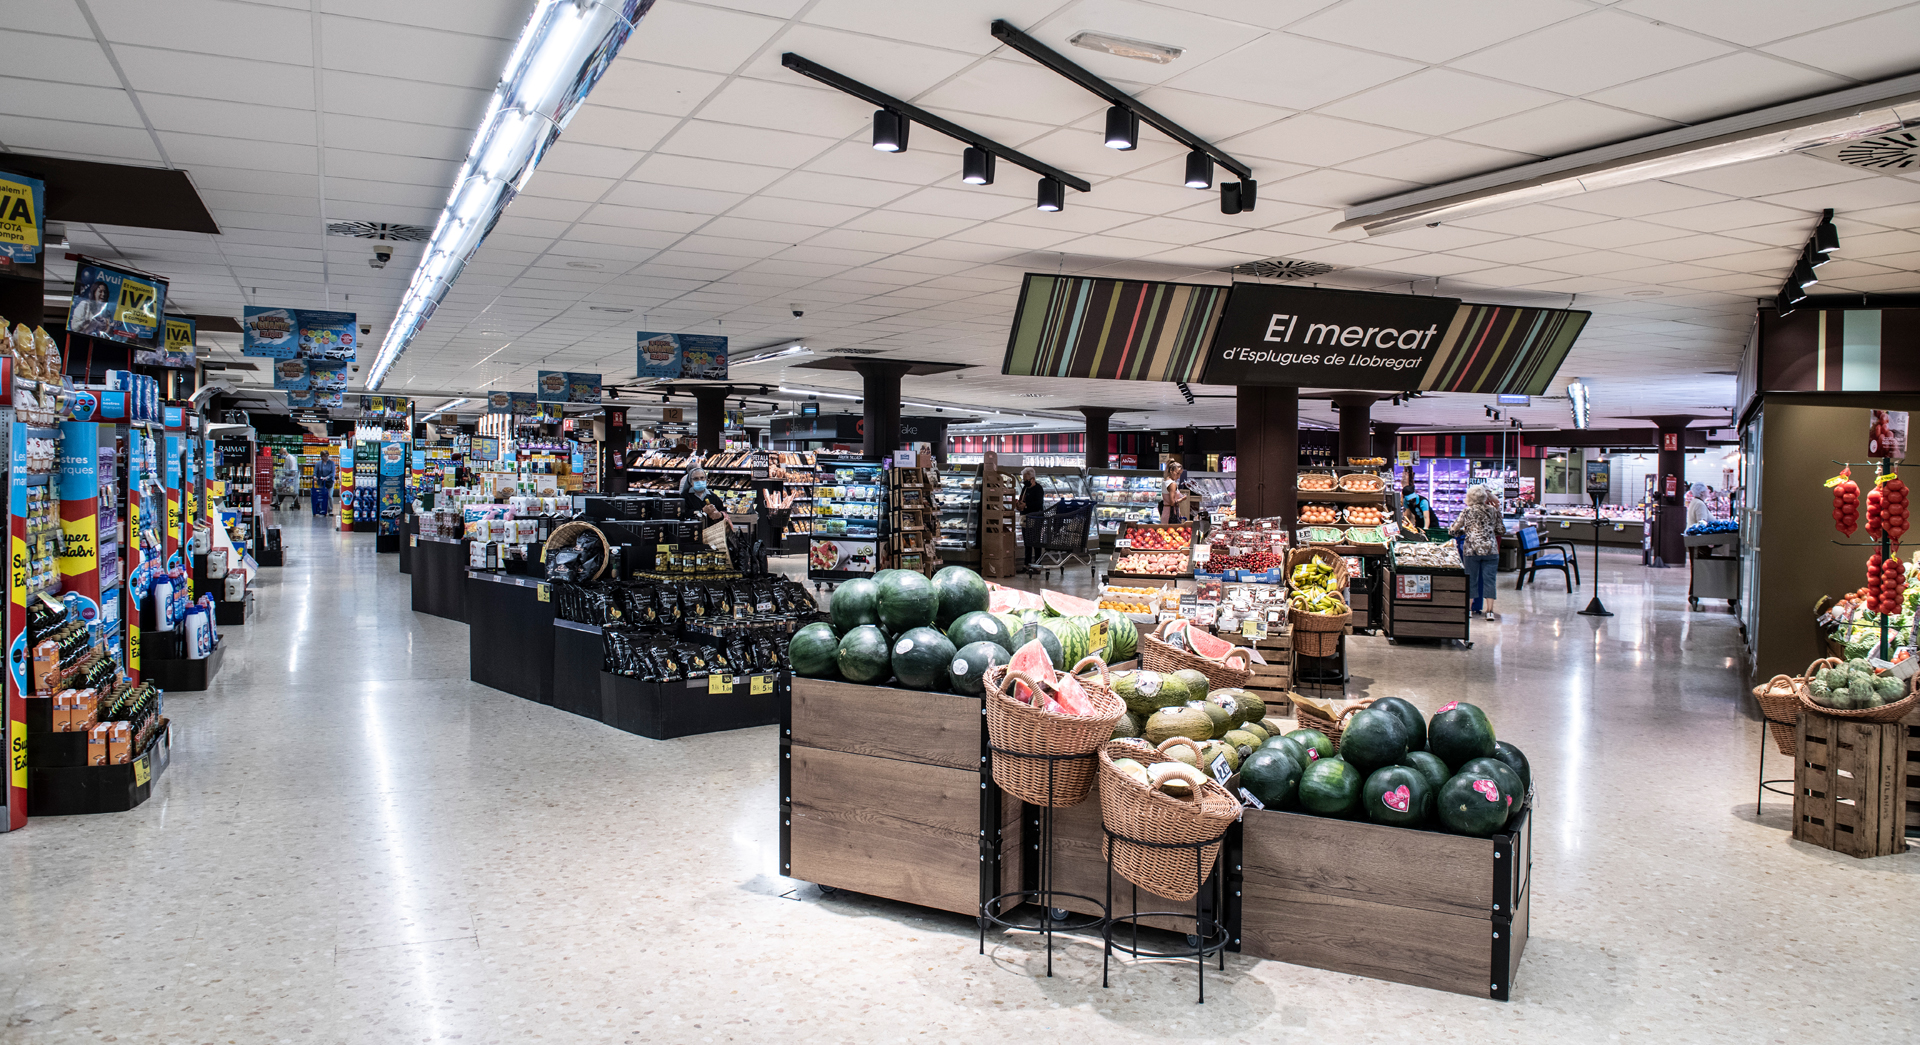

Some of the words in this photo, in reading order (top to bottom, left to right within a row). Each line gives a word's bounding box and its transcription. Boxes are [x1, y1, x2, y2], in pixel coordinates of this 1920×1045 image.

[97, 271, 122, 285] Avui
[121, 289, 155, 313] IVA
[166, 327, 191, 343] IVA
[1263, 313, 1298, 343] El
[1303, 323, 1438, 350] mercat
[1223, 347, 1320, 366] d'Esplugues
[1324, 353, 1345, 366] de
[1349, 354, 1423, 371] Llobregat
[668, 410, 678, 418] 12
[219, 445, 247, 453] RAIMAT
[483, 440, 491, 454] 5
[63, 533, 90, 545] uper
